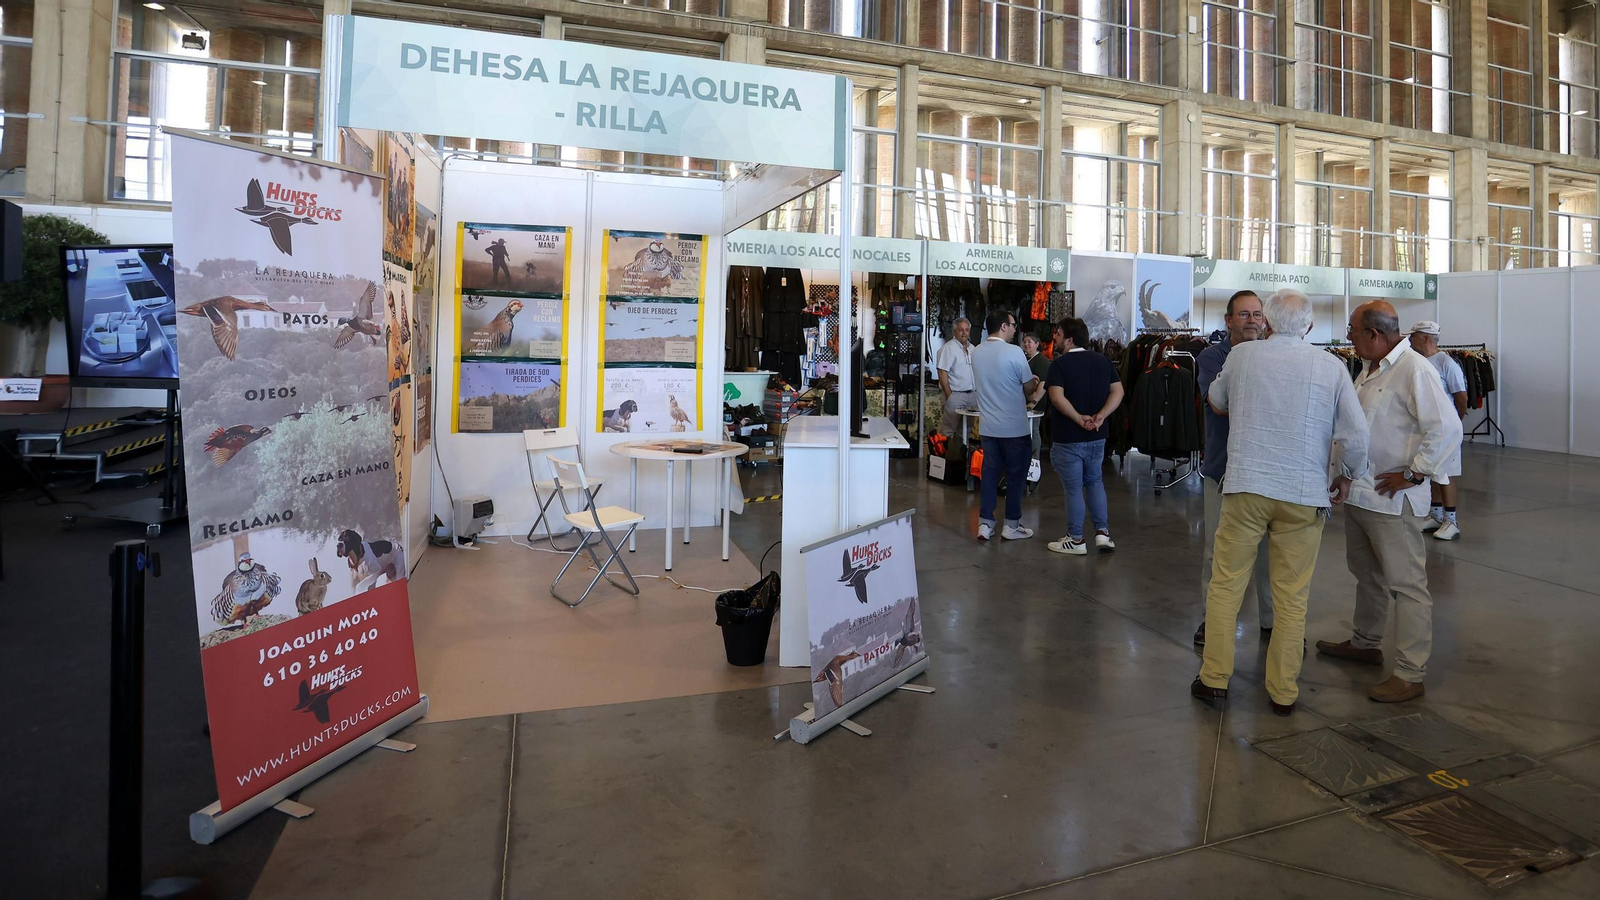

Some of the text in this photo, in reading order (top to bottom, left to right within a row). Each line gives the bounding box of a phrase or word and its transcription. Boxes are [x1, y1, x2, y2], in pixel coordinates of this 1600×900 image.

[400, 42, 802, 112] DEHESA LA REJAQUERA
[576, 102, 668, 134] RILLA
[674, 255, 699, 263] RECLAMO
[727, 241, 911, 262] RMERIA LOS ALCONOCALES
[966, 248, 1014, 260] ARMERIA
[276, 268, 334, 280] REJAQUERA
[936, 260, 1042, 276] LOS ALCORNOCALES
[1249, 272, 1310, 284] ARMERIA PATO
[1359, 279, 1413, 290] ARMERIA PATO
[283, 312, 328, 325] PATOS
[245, 387, 297, 401] OJEOS
[302, 461, 389, 485] CAZA EN MANO
[203, 510, 293, 539] RECLAMO
[849, 621, 855, 630] LA
[859, 605, 891, 625] REJAQUERA
[259, 607, 378, 664] JOAQUIN MOYA
[263, 628, 378, 687] 610 36 40 40
[863, 642, 889, 664] PATOS
[236, 686, 411, 786] WWW.HUNTSDUCKS.COM
